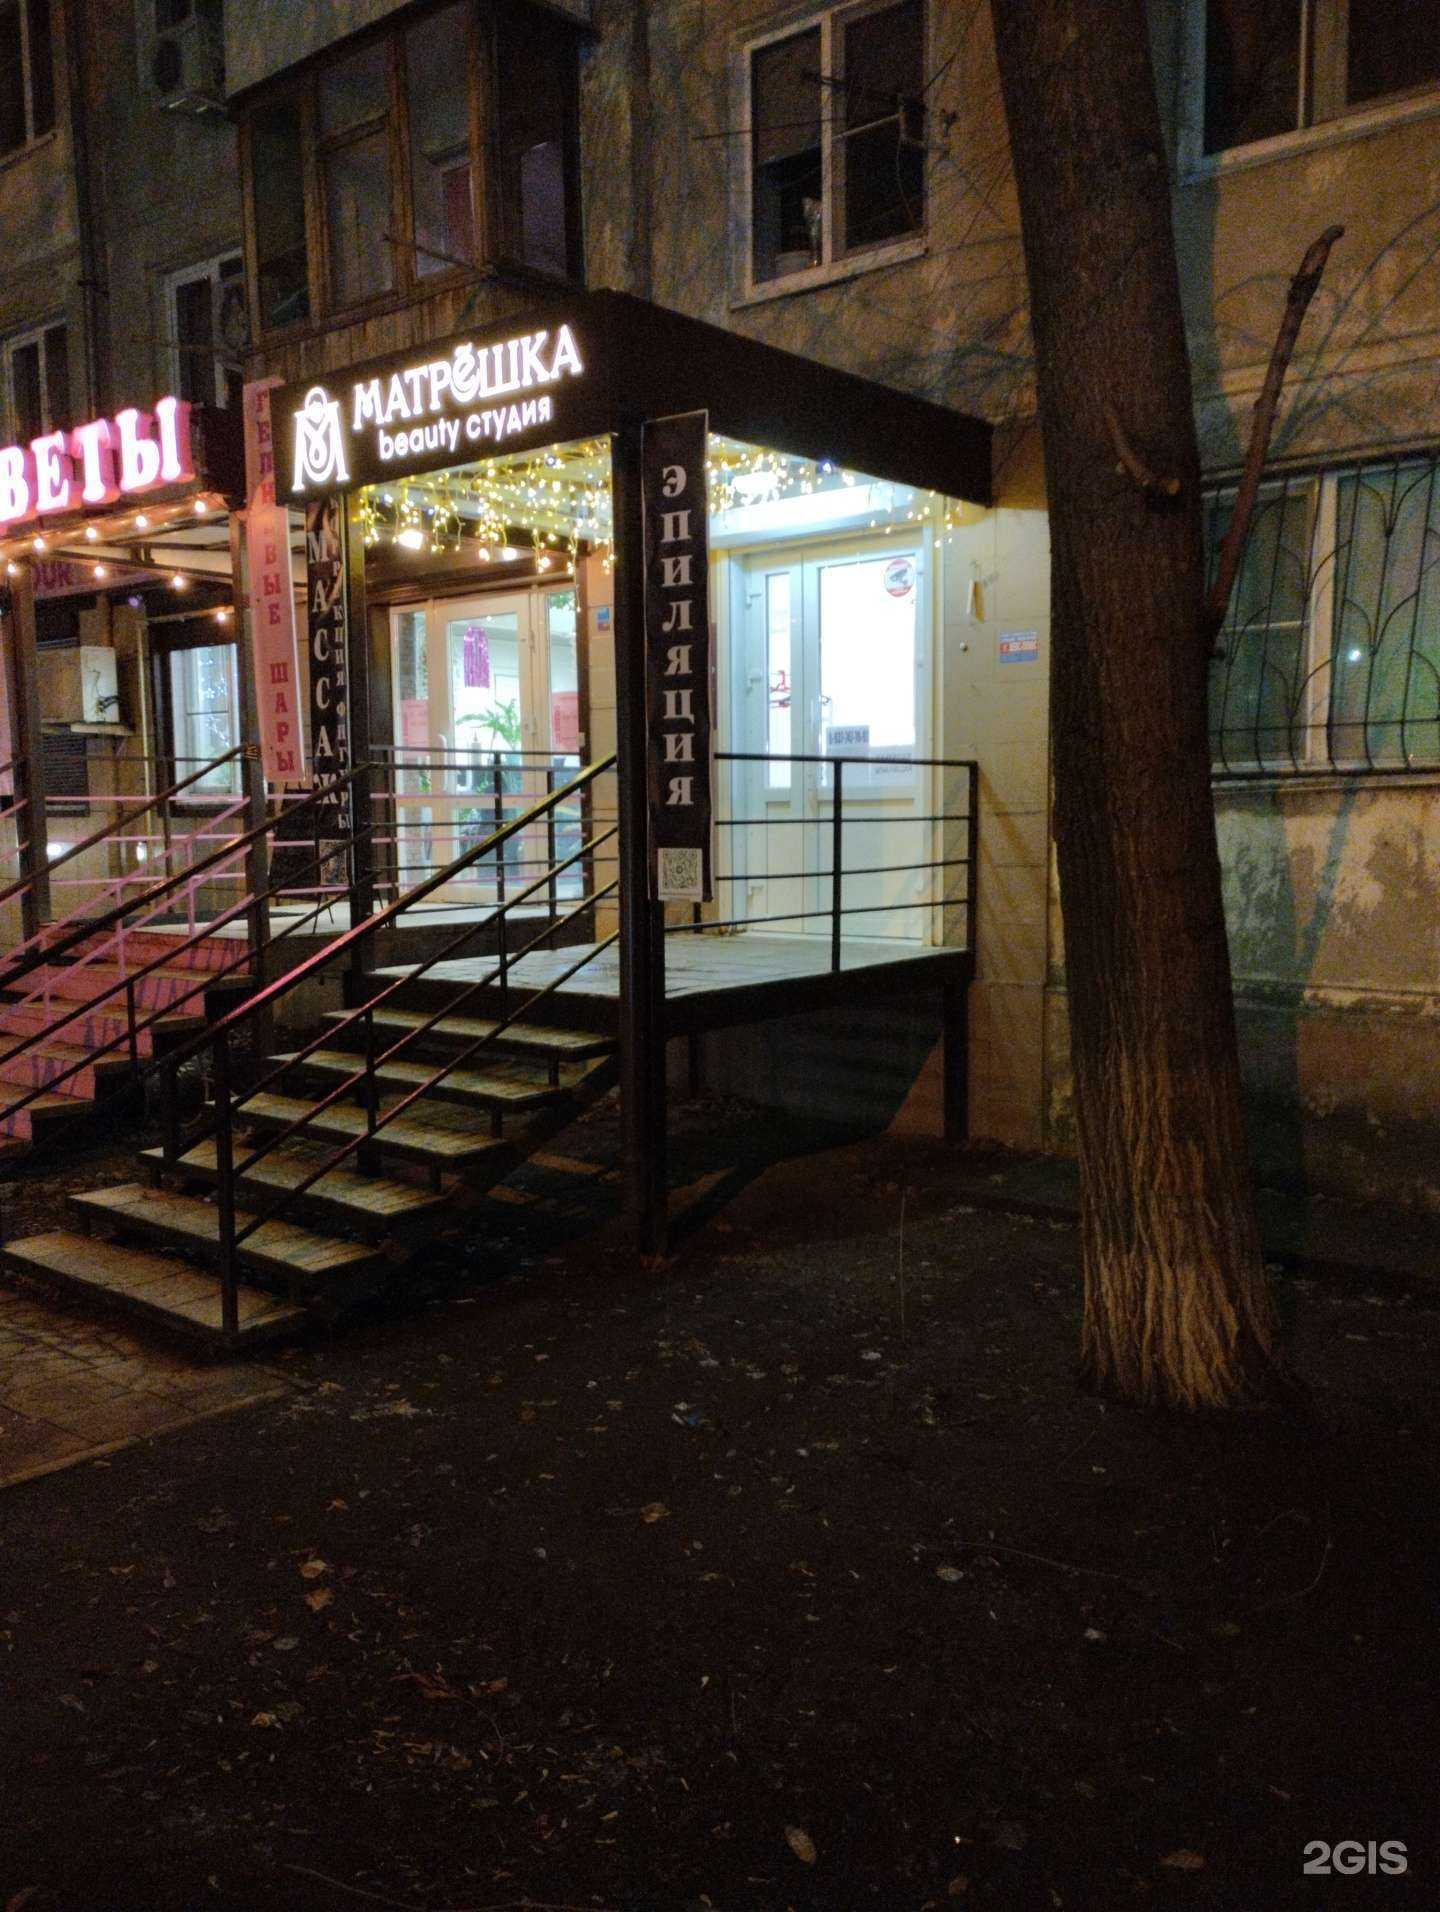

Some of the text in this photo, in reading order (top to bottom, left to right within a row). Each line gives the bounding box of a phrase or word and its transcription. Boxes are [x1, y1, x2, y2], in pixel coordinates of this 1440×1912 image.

[255, 391, 296, 773] ГЕЛИВЫЕ ШАРЫ
[377, 394, 555, 462] beauty студия
[307, 529, 341, 805] МАССАЖ
[659, 464, 696, 806] ЭПИЛЯЦИЯ
